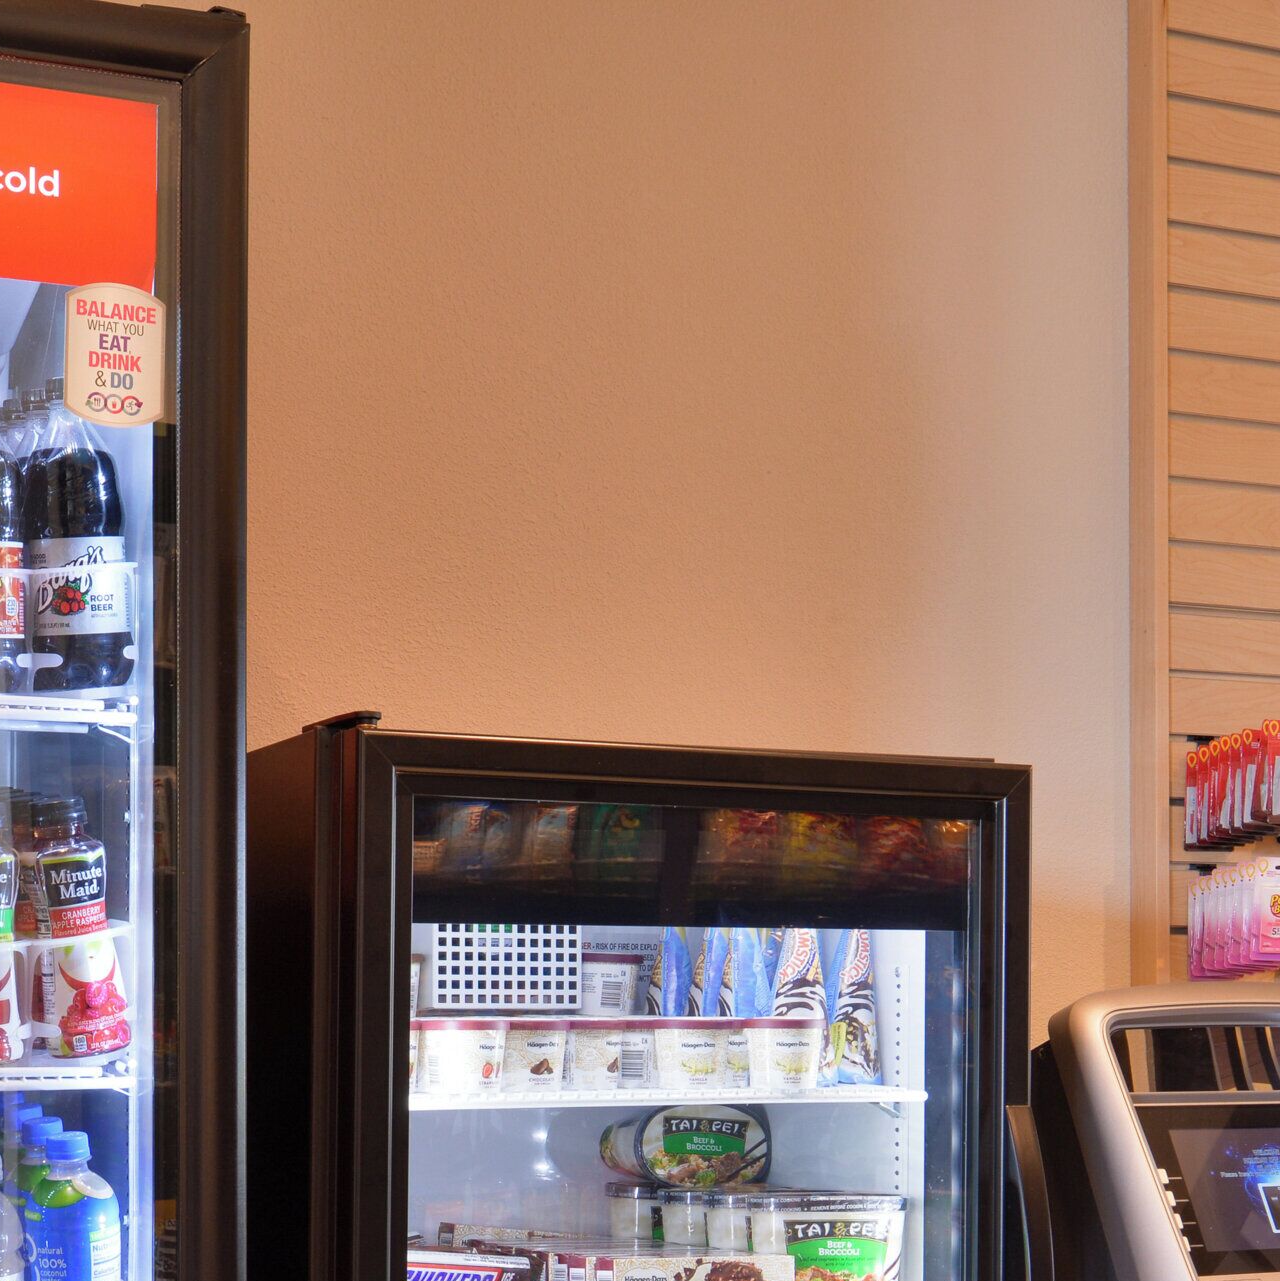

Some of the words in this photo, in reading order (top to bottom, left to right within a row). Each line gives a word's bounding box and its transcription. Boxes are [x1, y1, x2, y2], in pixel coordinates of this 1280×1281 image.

[75, 298, 158, 325] BALANCE
[87, 318, 120, 334] WHAT
[122, 322, 145, 337] YOU
[88, 350, 143, 374] DRINK
[94, 371, 108, 388] &
[109, 372, 135, 391] DO
[90, 593, 114, 602] ROOT
[90, 603, 114, 612] BEER
[50, 866, 103, 885] Minute
[59, 884, 100, 900] Maid
[61, 905, 101, 921] CRANBERRY
[595, 942, 609, 951] RISK
[670, 1118, 698, 1132] TAI
[711, 1121, 740, 1135] PEI
[686, 1143, 723, 1152] BROCCOLI
[794, 1223, 830, 1237] TAI
[827, 1240, 845, 1249] BEEF
[818, 1247, 861, 1257] BROCCOLI
[39, 1258, 67, 1269] 100%
[40, 1269, 67, 1277] coconut
